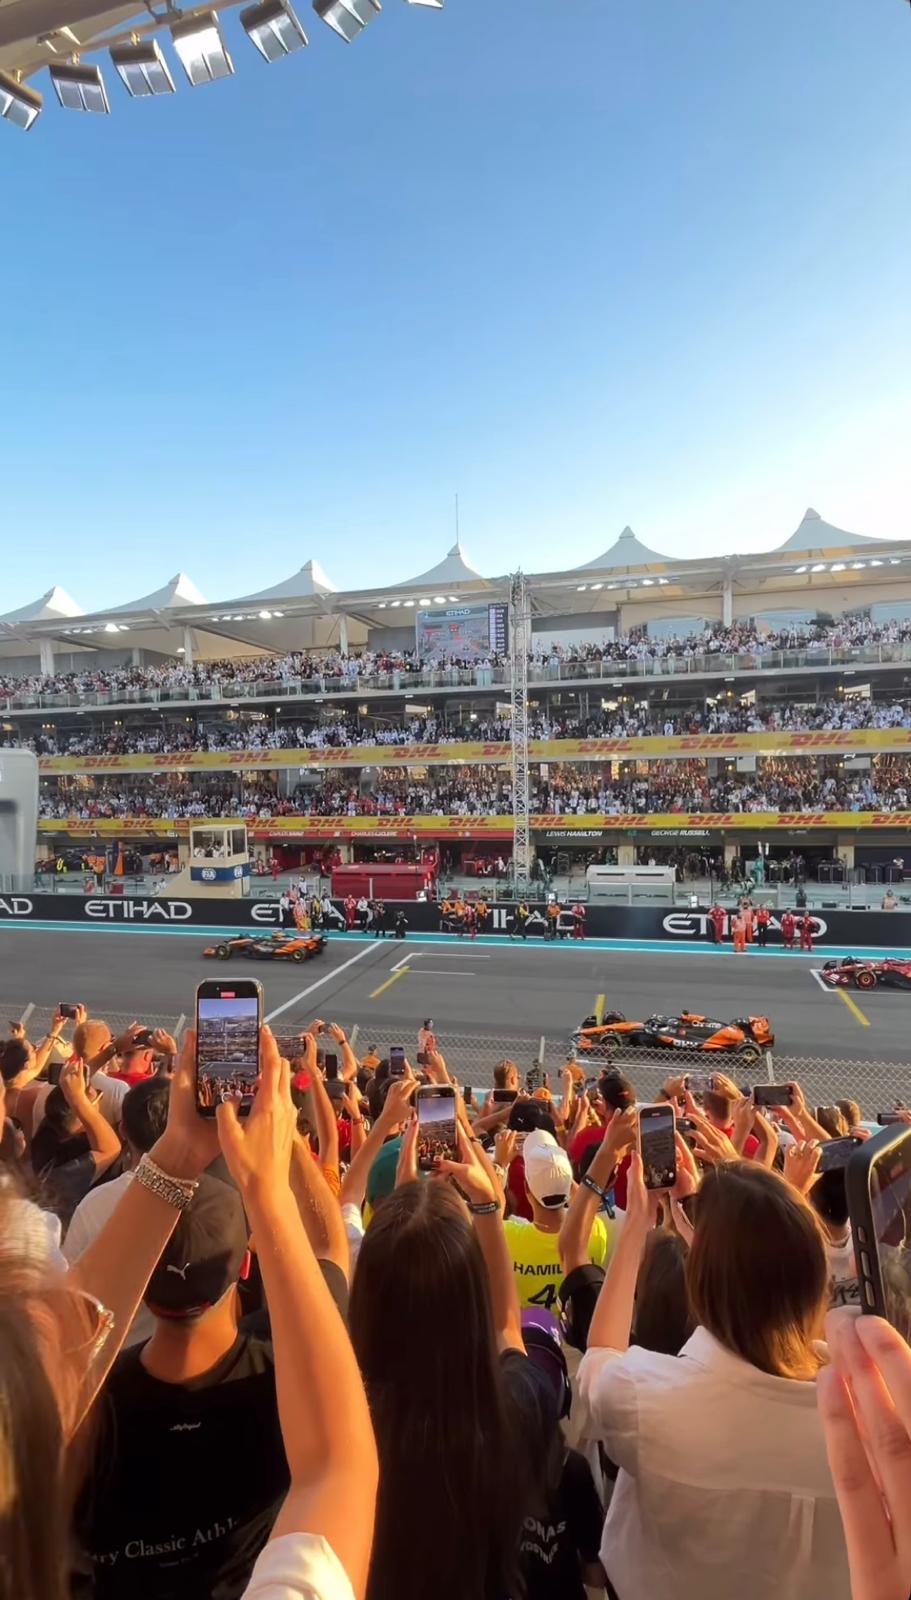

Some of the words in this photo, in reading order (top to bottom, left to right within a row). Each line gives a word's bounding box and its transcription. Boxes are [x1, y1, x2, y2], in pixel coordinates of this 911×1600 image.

[680, 736, 740, 749] DHL
[789, 732, 853, 746] DHL
[578, 740, 632, 753] DHL
[229, 751, 273, 763] DHL
[308, 749, 353, 761] DHL
[393, 746, 441, 759] DHL
[83, 757, 121, 768] DHL
[154, 753, 195, 765] DHL
[66, 820, 97, 829] DHL
[122, 820, 154, 828] DHL
[245, 819, 279, 828] DHL
[308, 818, 345, 828] DHL
[376, 818, 416, 827] DHL
[447, 817, 489, 827] DHL
[602, 816, 649, 826] DHL
[687, 815, 736, 825] DHL
[776, 814, 829, 825] DHL
[84, 900, 193, 920] ETIHAD
[513, 1261, 563, 1276] HAMIL
[92, 1551, 120, 1567] try
[124, 1533, 187, 1559] Classic
[192, 1515, 239, 1547] Athl
